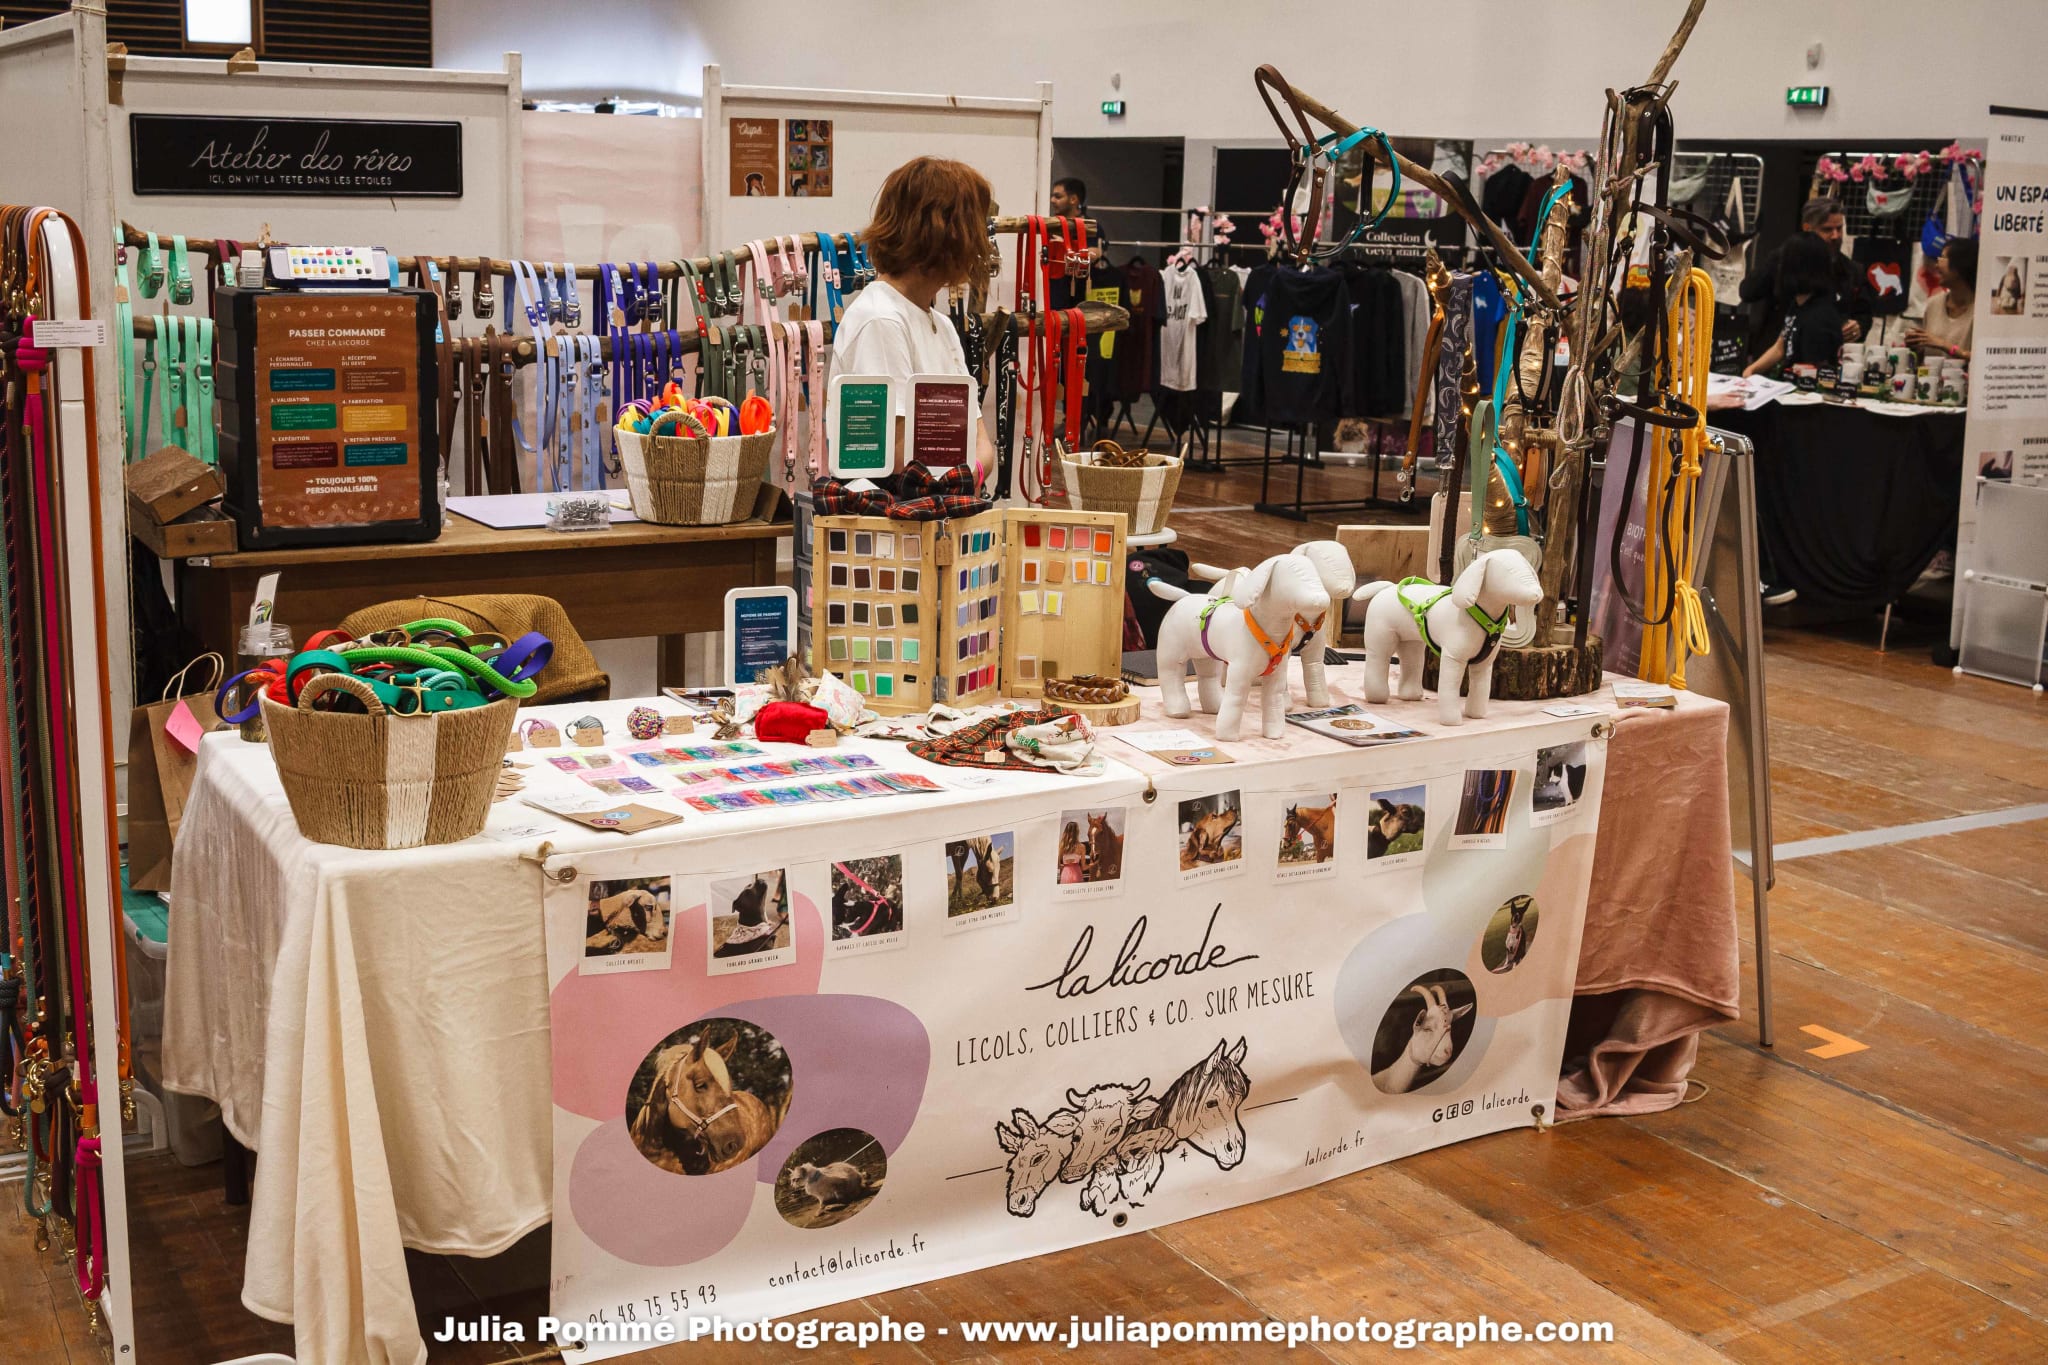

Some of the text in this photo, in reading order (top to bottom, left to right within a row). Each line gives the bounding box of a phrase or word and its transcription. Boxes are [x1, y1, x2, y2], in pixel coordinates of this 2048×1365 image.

[189, 125, 413, 172] Atelier des rêves
[208, 175, 224, 185] ICI,
[228, 175, 242, 184] ON
[246, 175, 260, 184] VIT
[263, 175, 276, 184] LA
[306, 176, 331, 185] DANS
[334, 176, 352, 185] LES
[1996, 185, 2017, 201] UN
[1993, 210, 2044, 233] LIBERTÉ
[1366, 231, 1421, 244] Collection
[288, 328, 386, 338] PASSER COMMANDE
[305, 484, 378, 495] PERSONNALISABLE
[315, 475, 378, 486] TOUJOURS 100%
[956, 1026, 1034, 1067] LICOLS,
[1045, 1005, 1139, 1049] COLLIERS
[1165, 999, 1195, 1026] CO.
[1204, 985, 1238, 1018] SUR
[1247, 971, 1316, 1010] MESURE
[1481, 1088, 1531, 1111] lalicorde
[1305, 1129, 1365, 1167] lalicorde.fr
[768, 1235, 926, 1289] contact@lalicorde.fr
[617, 1303, 636, 1322] 48
[644, 1296, 662, 1318] 75
[671, 1288, 689, 1312] 55
[698, 1283, 718, 1306] 93
